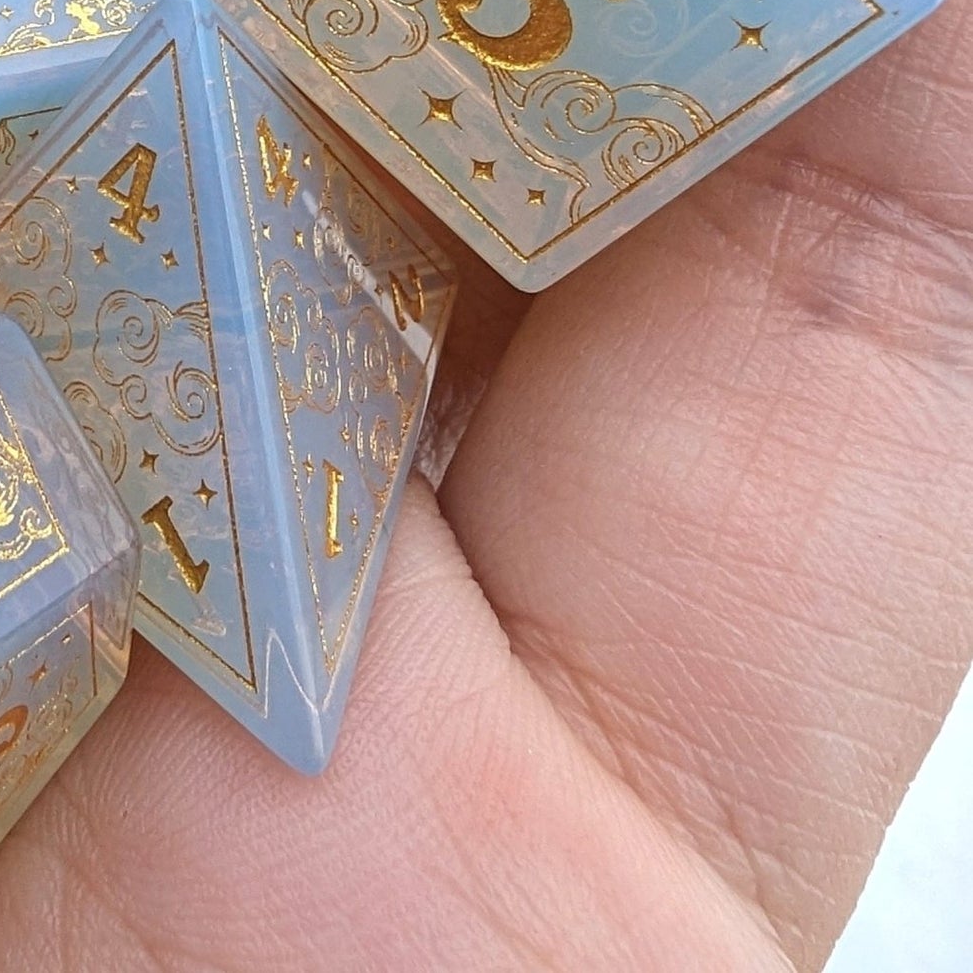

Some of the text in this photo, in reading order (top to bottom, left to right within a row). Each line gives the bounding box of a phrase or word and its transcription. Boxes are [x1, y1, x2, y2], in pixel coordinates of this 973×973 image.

[98, 142, 160, 244] 4
[256, 114, 299, 208] 4
[141, 496, 210, 594] 1
[322, 458, 345, 559] 1
